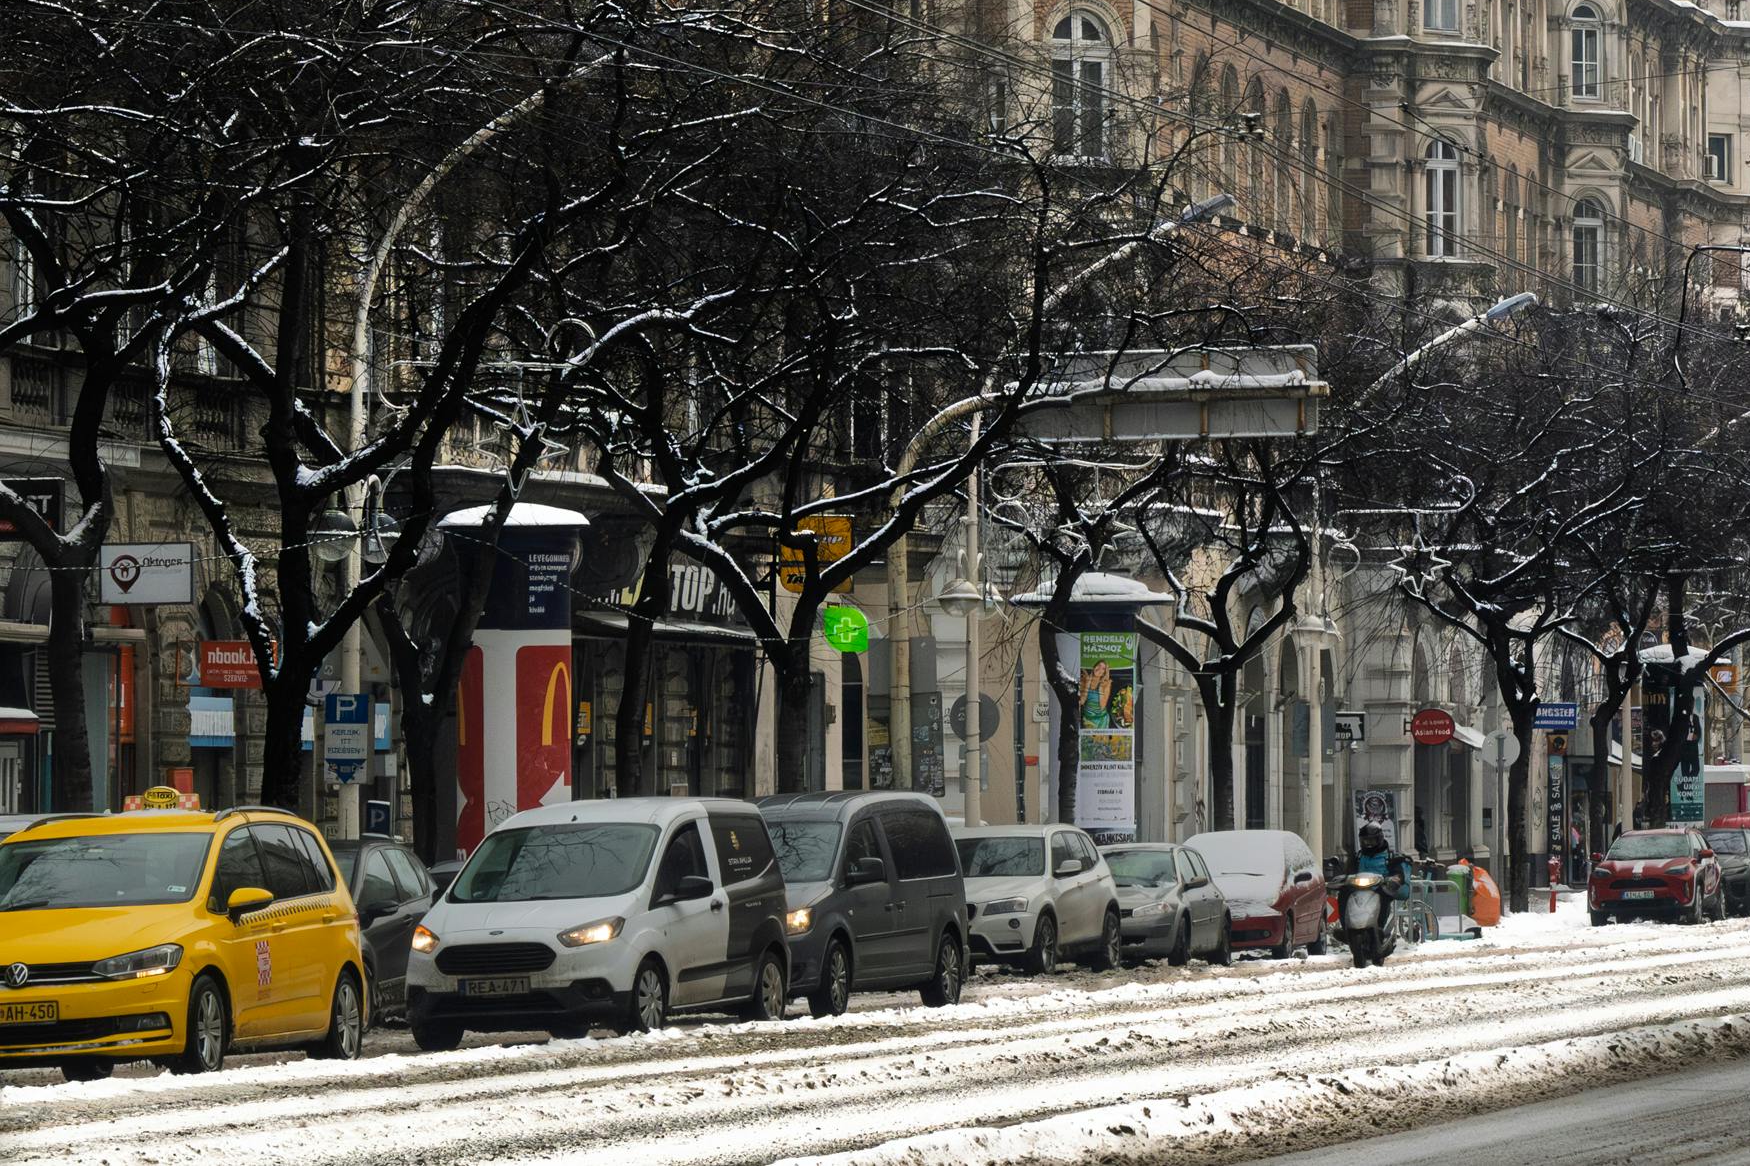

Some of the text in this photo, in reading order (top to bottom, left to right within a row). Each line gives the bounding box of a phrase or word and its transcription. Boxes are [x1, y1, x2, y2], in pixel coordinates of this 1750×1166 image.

[207, 647, 259, 665] nbook.h
[336, 696, 357, 722] P
[1536, 707, 1575, 717] ANGSTER
[1435, 728, 1451, 736] food
[1551, 773, 1561, 799] SALE
[1551, 815, 1561, 841] SALE
